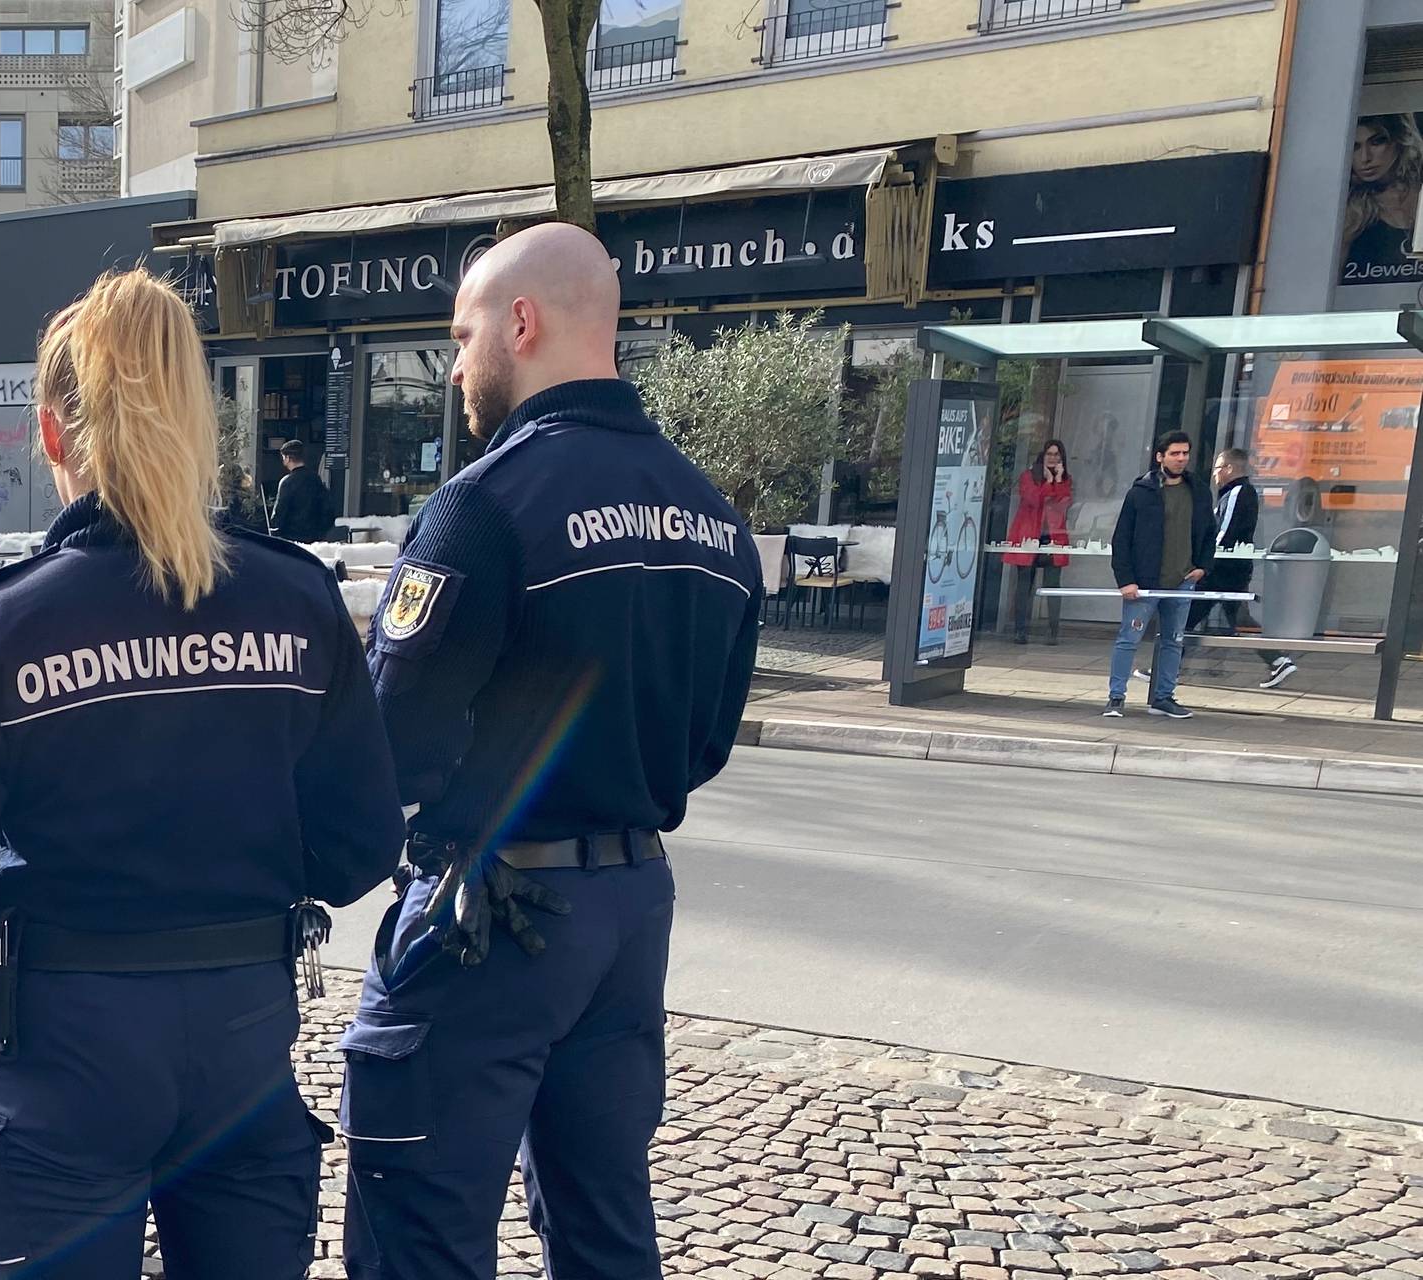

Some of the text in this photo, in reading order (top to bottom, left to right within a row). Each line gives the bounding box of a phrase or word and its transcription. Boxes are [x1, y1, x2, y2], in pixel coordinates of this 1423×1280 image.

[635, 228, 785, 274] brunch
[276, 254, 440, 301] TOFINO
[938, 426, 966, 455] BIKE!
[567, 503, 737, 557] ORDNUNGSAMT
[17, 632, 308, 703] ORDNUNGSAMT
